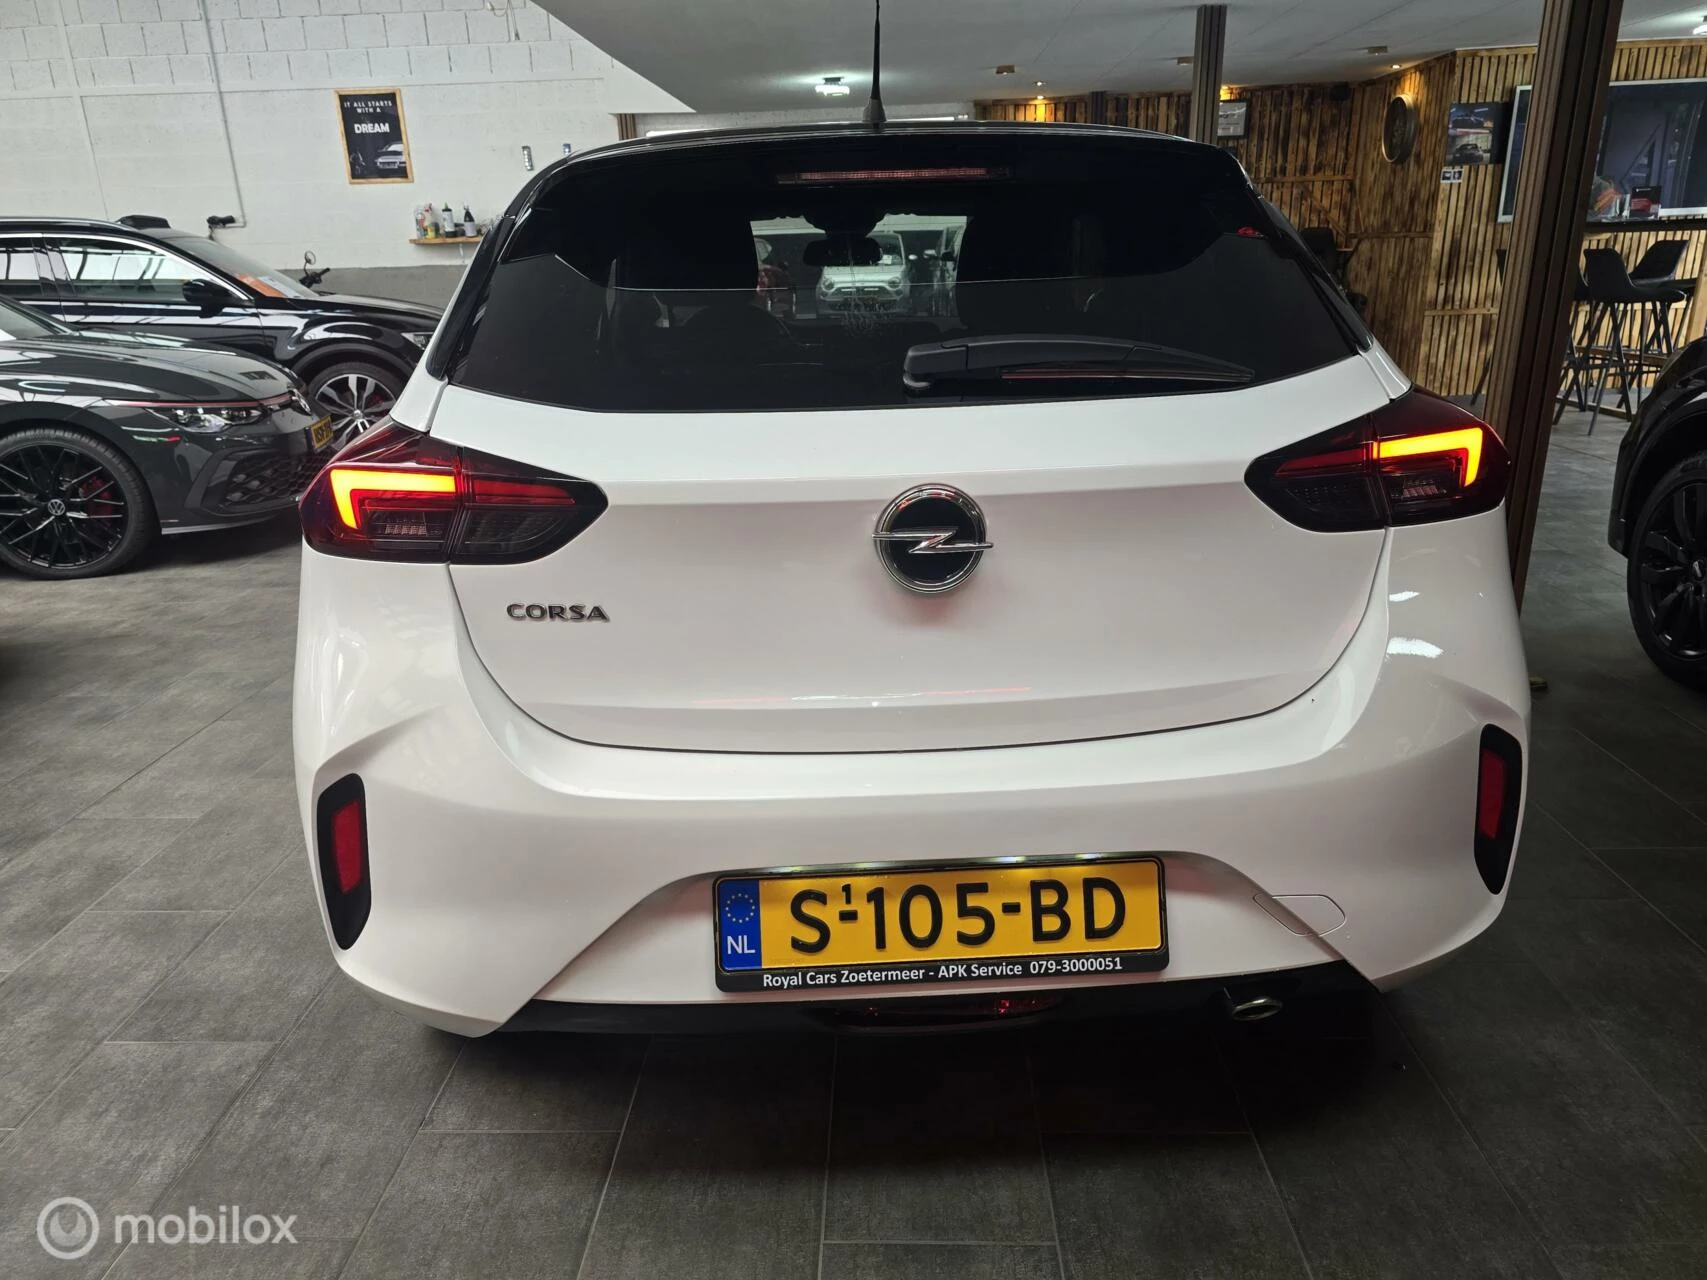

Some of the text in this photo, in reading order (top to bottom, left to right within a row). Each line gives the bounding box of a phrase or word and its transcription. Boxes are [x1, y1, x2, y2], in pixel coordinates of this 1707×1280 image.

[354, 122, 390, 134] DREAM
[506, 603, 610, 622] CORSA
[726, 934, 756, 955] NL
[763, 972, 802, 989] Royal
[806, 971, 837, 985] Cars
[840, 966, 925, 984] Zoetermeer
[938, 963, 967, 979] APK
[970, 961, 1022, 978] Service
[1029, 956, 1123, 975] 079-3000051
